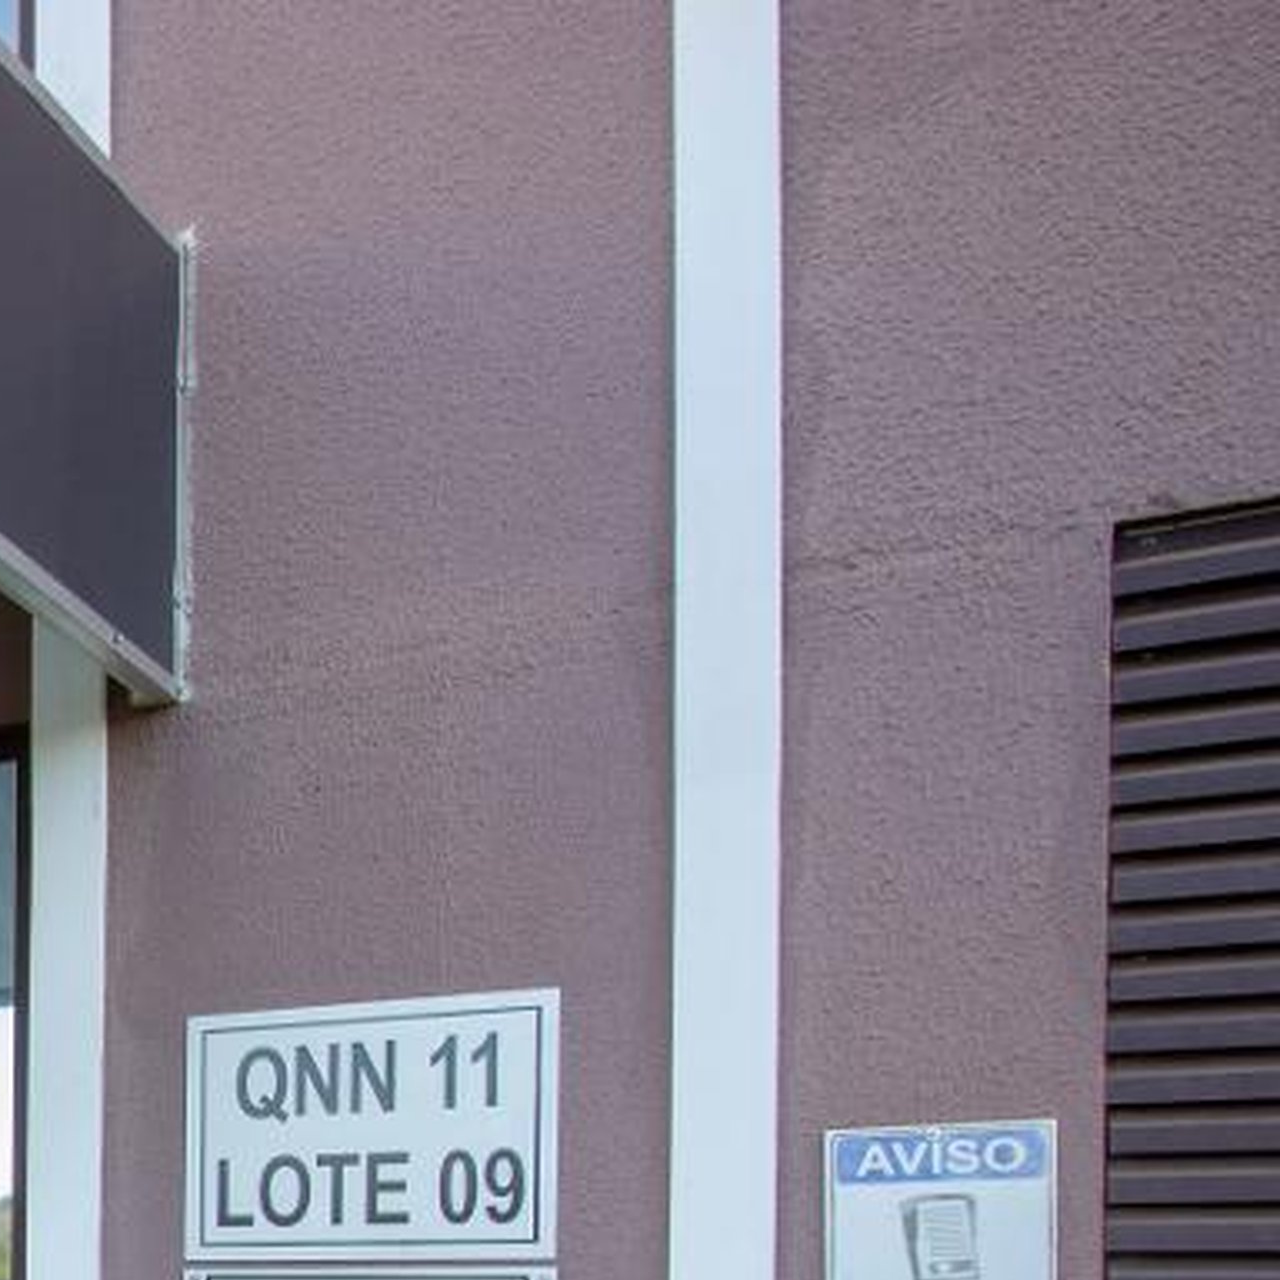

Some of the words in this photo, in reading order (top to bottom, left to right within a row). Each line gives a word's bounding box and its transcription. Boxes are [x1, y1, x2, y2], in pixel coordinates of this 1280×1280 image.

[236, 1039, 396, 1122] QNN
[428, 1031, 500, 1110] 11
[216, 1151, 411, 1227] LOTE
[439, 1148, 526, 1225] 09
[856, 1135, 1027, 1178] AVISO
